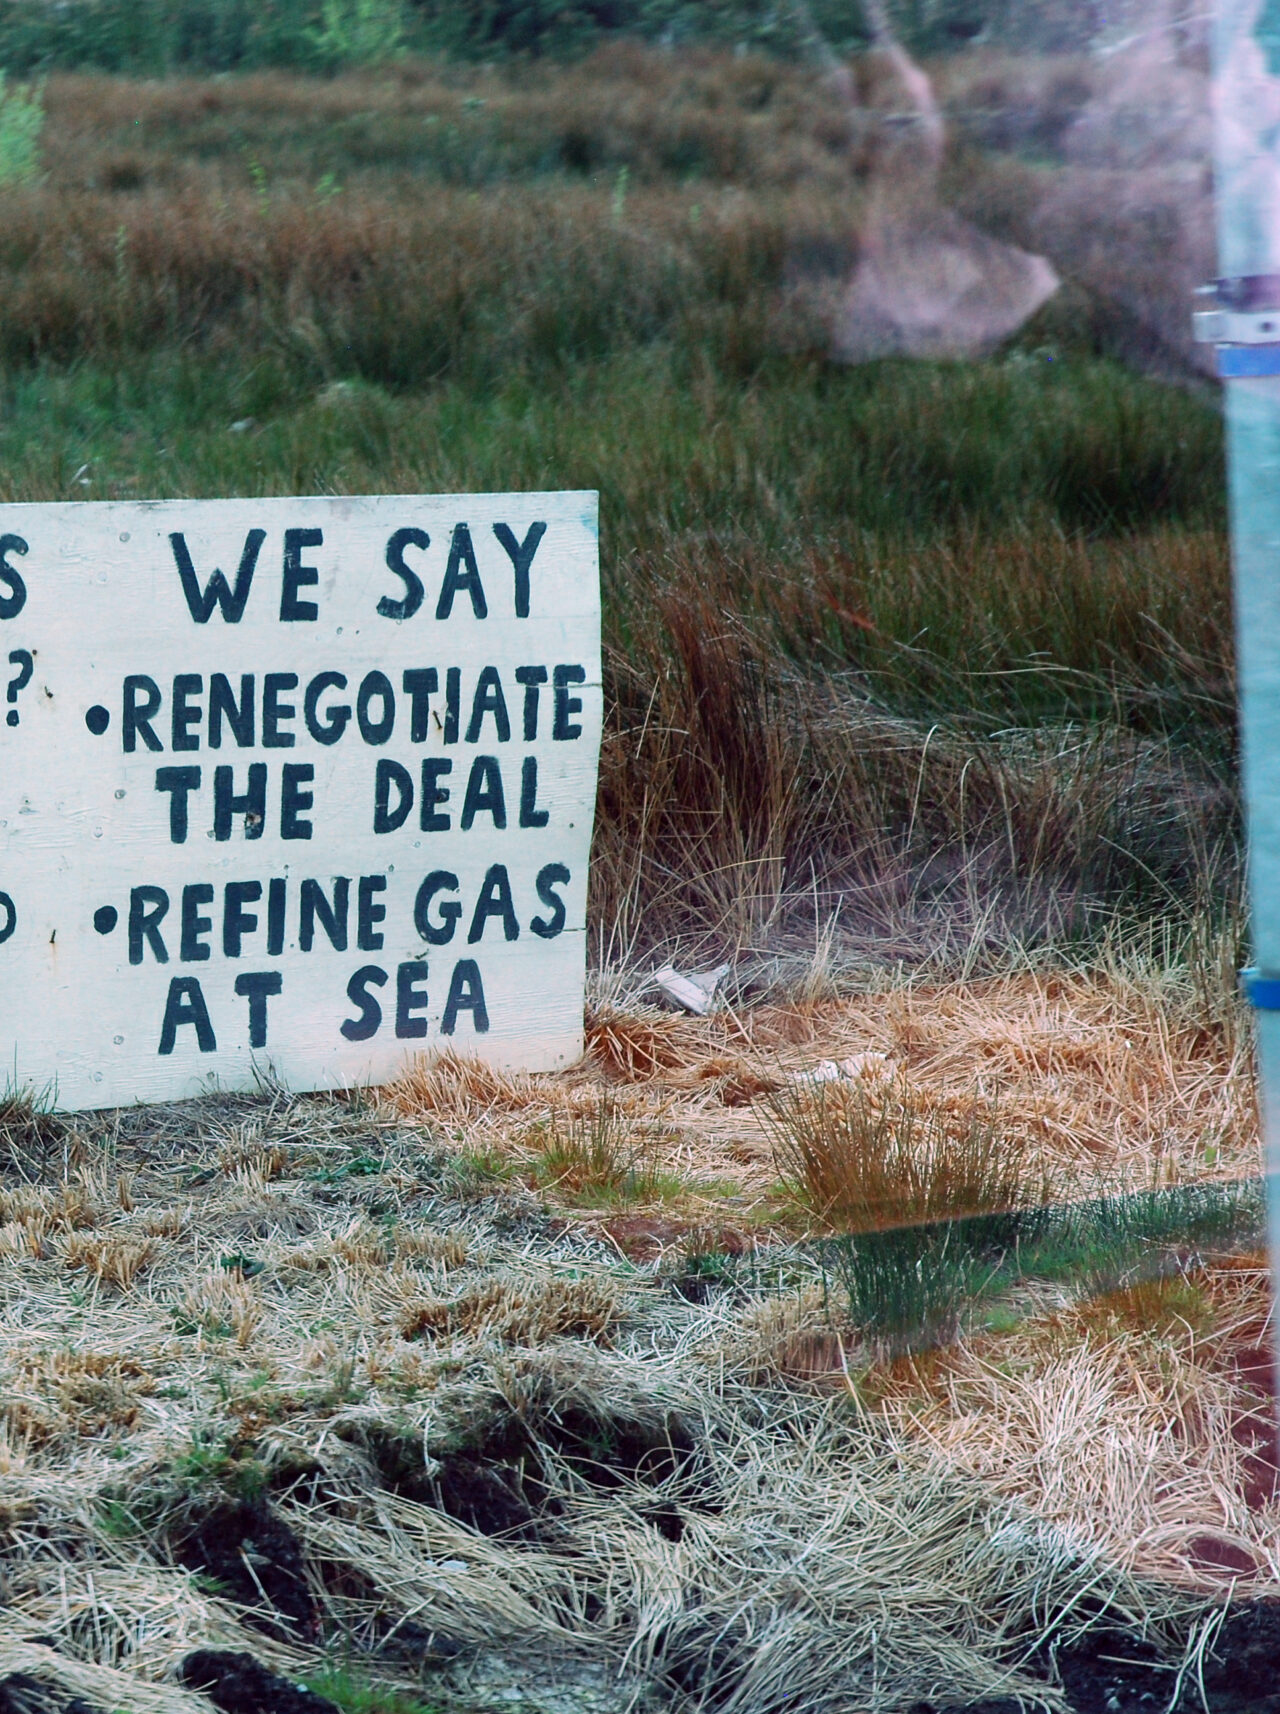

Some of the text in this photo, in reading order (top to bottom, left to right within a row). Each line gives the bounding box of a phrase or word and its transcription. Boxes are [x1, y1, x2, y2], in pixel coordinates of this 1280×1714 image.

[168, 522, 547, 623] WE SAY
[122, 664, 585, 752] RENEGOTIATE
[155, 755, 549, 844] THE DEAL
[128, 863, 571, 965] REFINE GAS
[158, 959, 490, 1055] AT SEA
